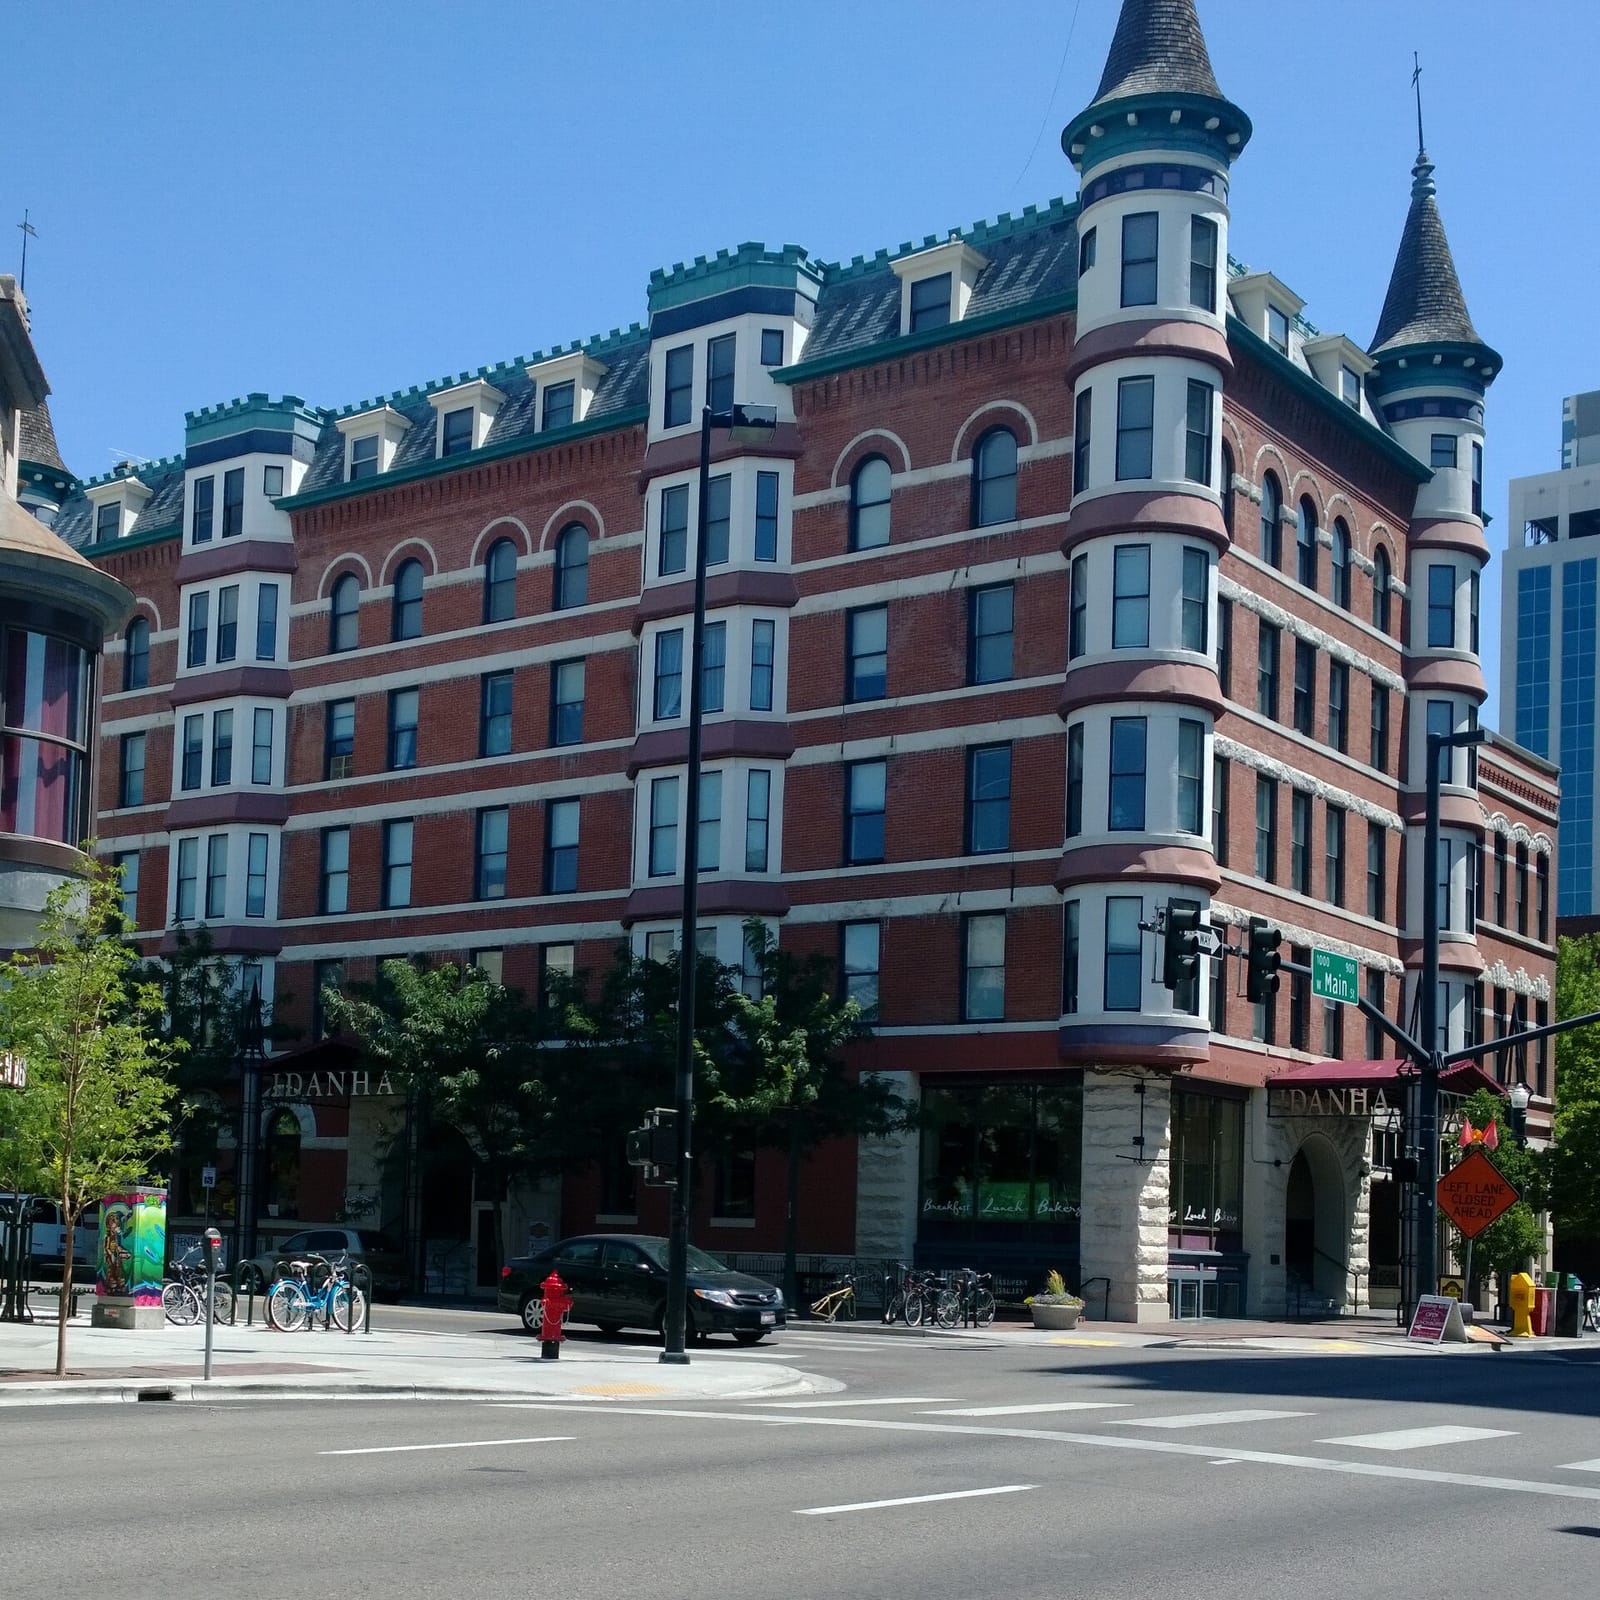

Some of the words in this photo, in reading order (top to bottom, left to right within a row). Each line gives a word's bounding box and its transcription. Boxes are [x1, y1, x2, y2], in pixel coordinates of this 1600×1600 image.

[1316, 954, 1330, 968] 1000
[1345, 962, 1355, 975] 900
[1324, 971, 1348, 997] Main
[272, 1070, 395, 1097] IDANHA
[1280, 1088, 1390, 1116] IDANHA
[1443, 1181, 1470, 1193] LEFT
[1475, 1183, 1505, 1195] LANE
[923, 1199, 969, 1216] Breakfast
[982, 1197, 1025, 1214] Lunch
[1037, 1199, 1081, 1217] Bakery
[1451, 1193, 1496, 1207] CLOSED
[1452, 1206, 1493, 1219] AHEAD
